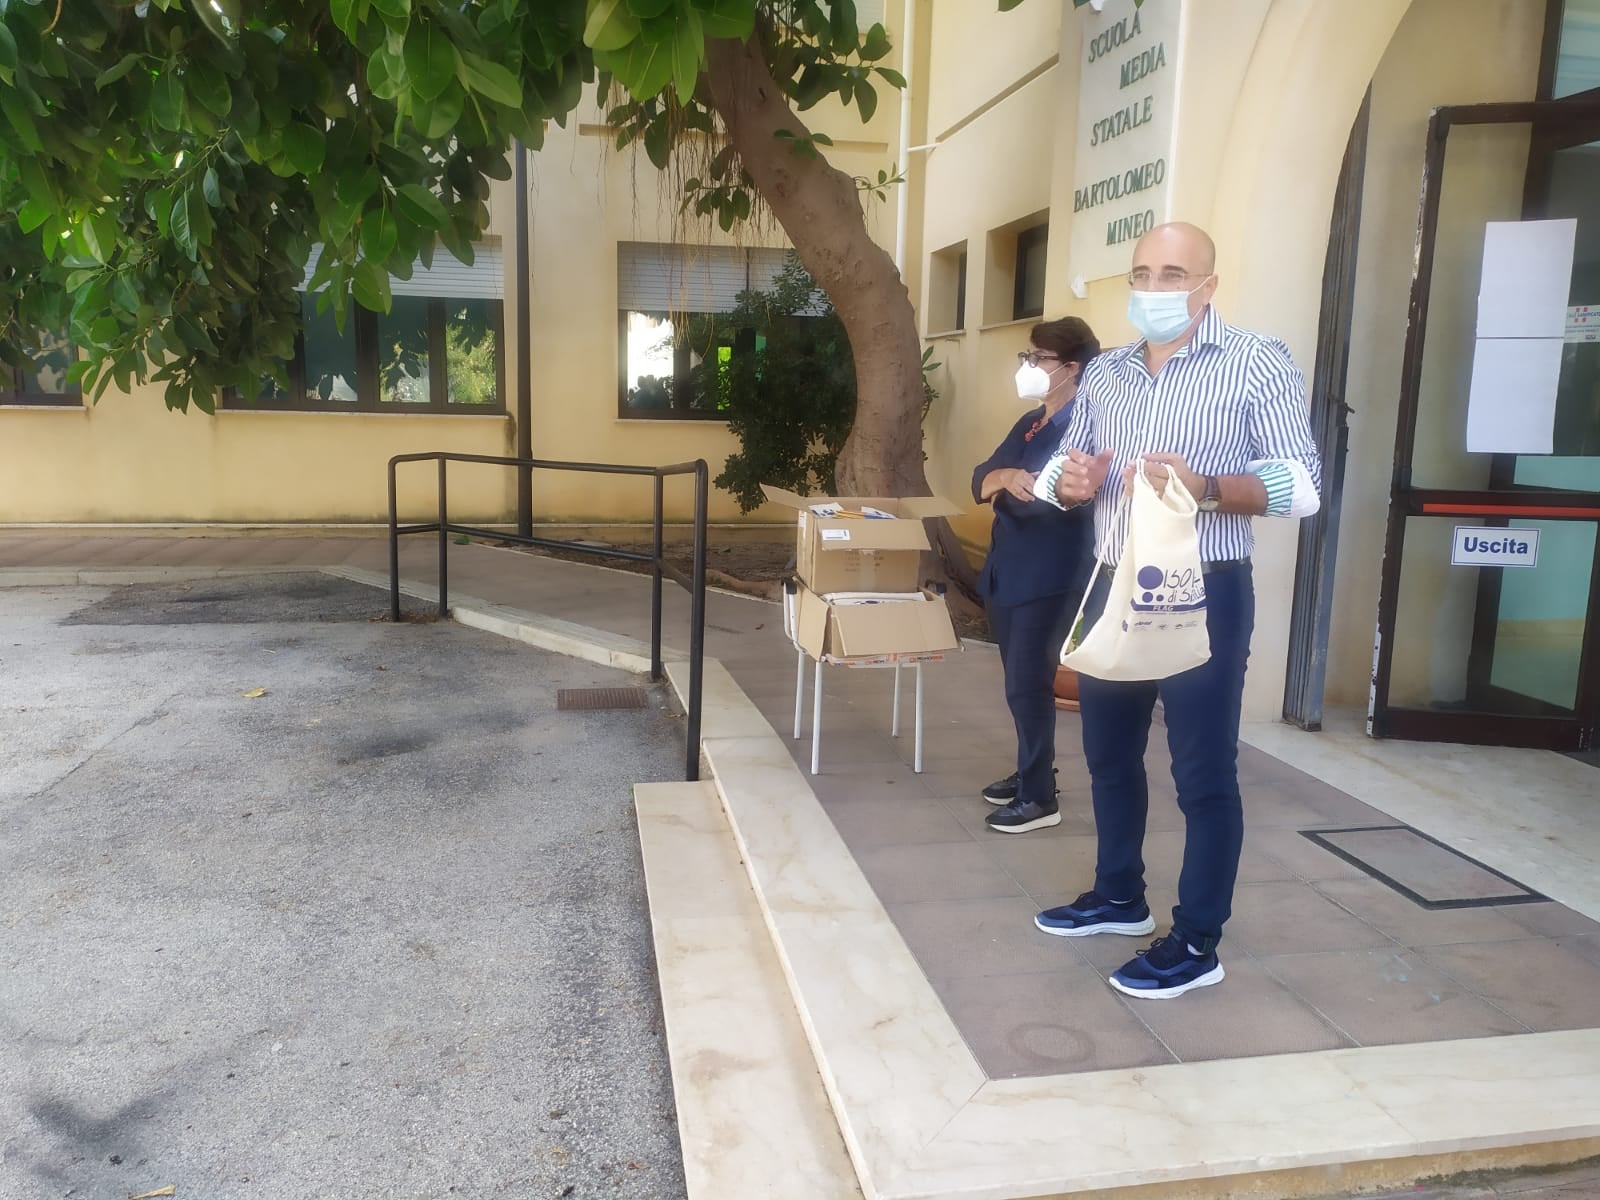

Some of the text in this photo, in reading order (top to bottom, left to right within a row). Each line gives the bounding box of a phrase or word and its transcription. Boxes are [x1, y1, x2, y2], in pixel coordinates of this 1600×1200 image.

[1088, 10, 1142, 64] SCUOLA
[1119, 42, 1167, 90] MEDIA
[1090, 95, 1154, 147] STATALE
[1073, 158, 1166, 213] BARTOLOMEO
[1106, 209, 1155, 246] MINEO
[1463, 536, 1529, 554] Uscita
